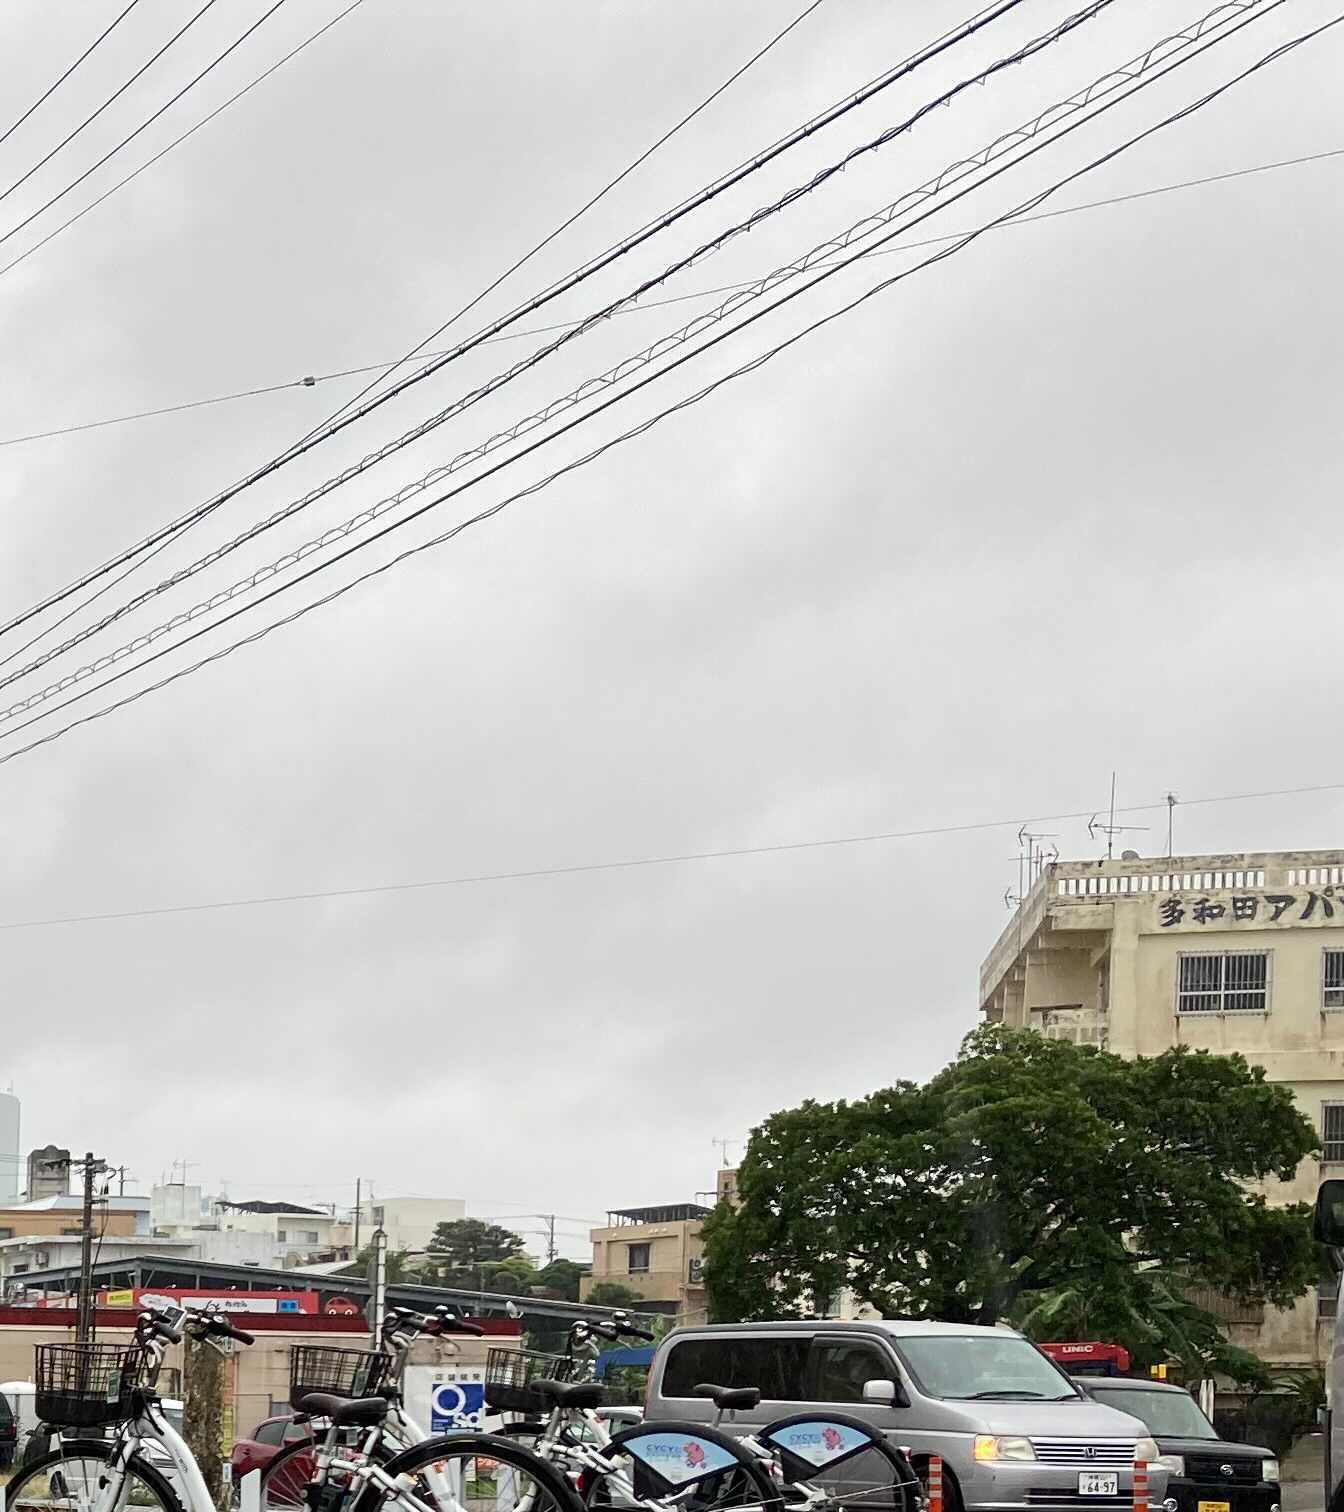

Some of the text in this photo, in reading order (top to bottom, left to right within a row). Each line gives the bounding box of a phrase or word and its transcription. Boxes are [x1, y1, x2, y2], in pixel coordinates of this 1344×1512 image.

[1159, 886, 1344, 927] 多和田アパ
[1062, 1345, 1094, 1353] UNIC
